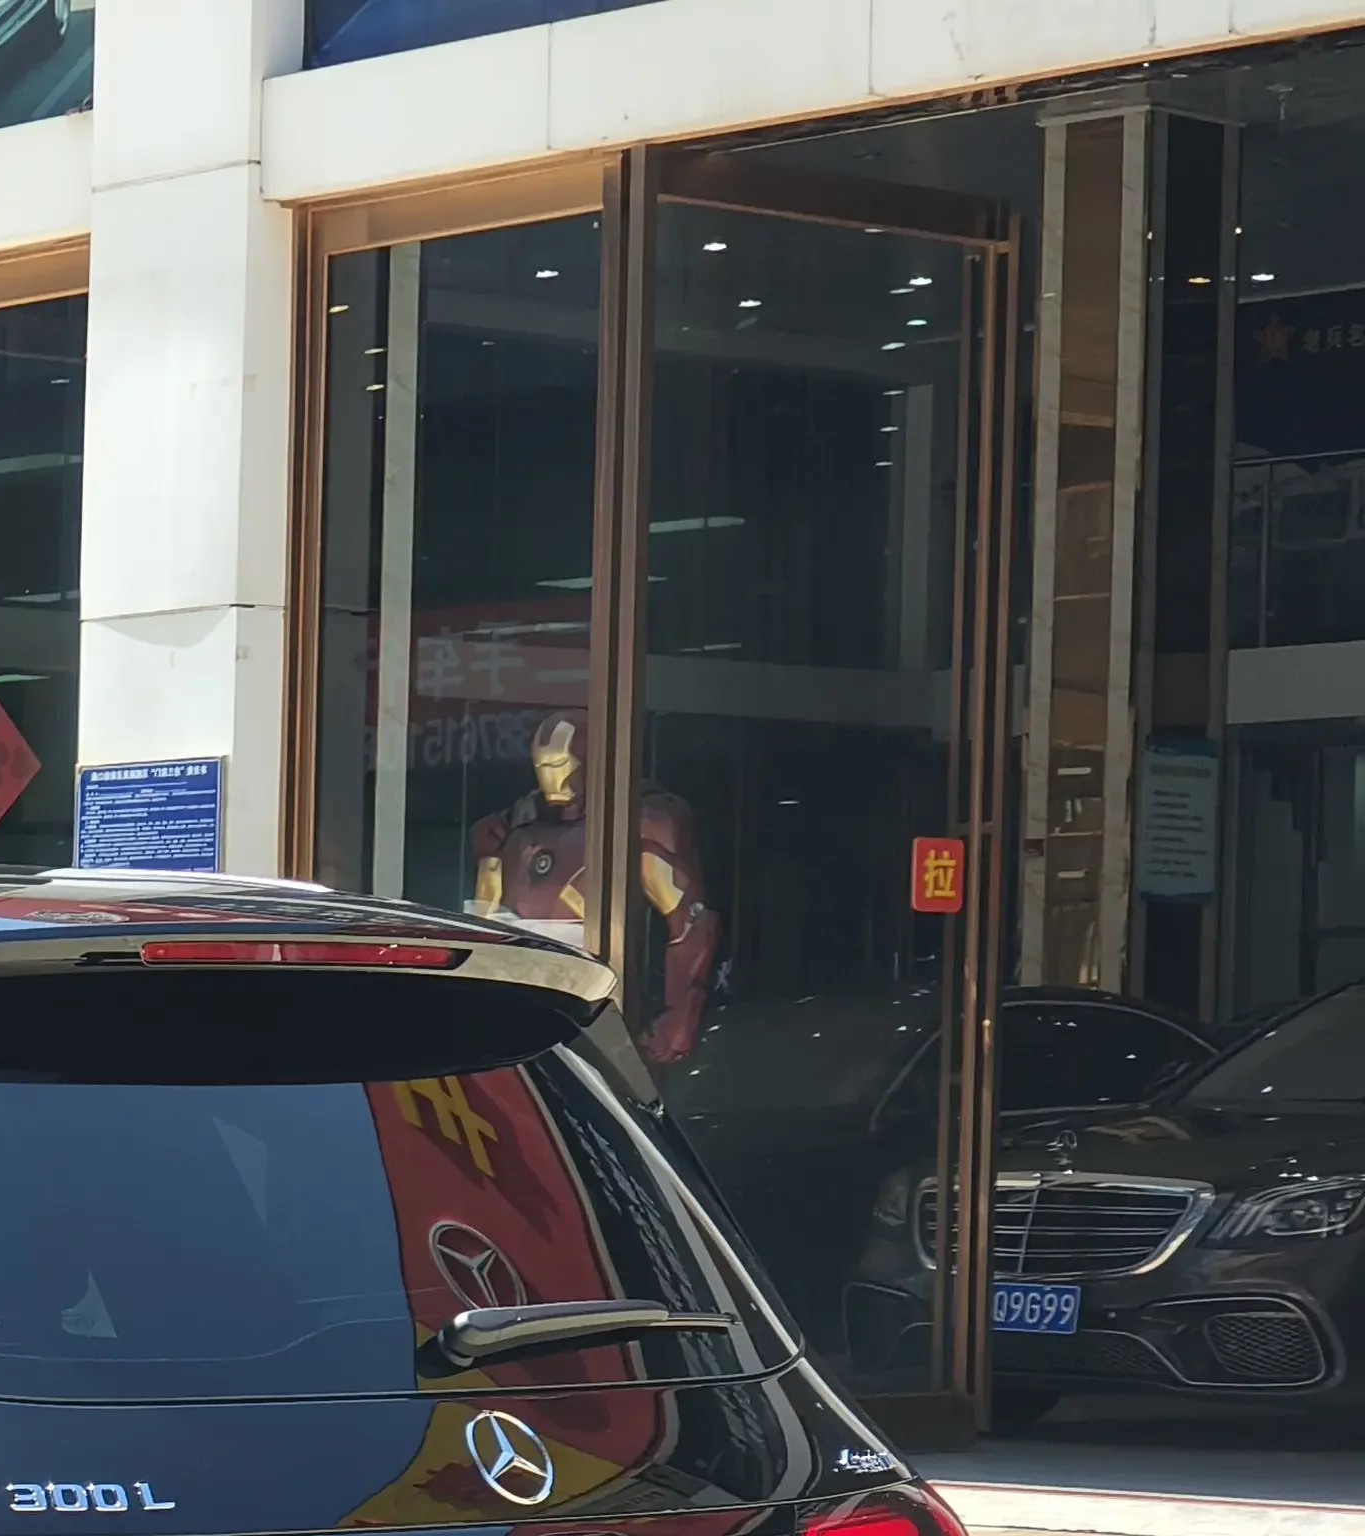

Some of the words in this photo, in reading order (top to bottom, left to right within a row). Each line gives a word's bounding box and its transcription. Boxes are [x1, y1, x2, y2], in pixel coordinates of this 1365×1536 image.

[924, 849, 957, 898] 拉
[8, 1482, 129, 1512] 300
[135, 1481, 176, 1511] L
